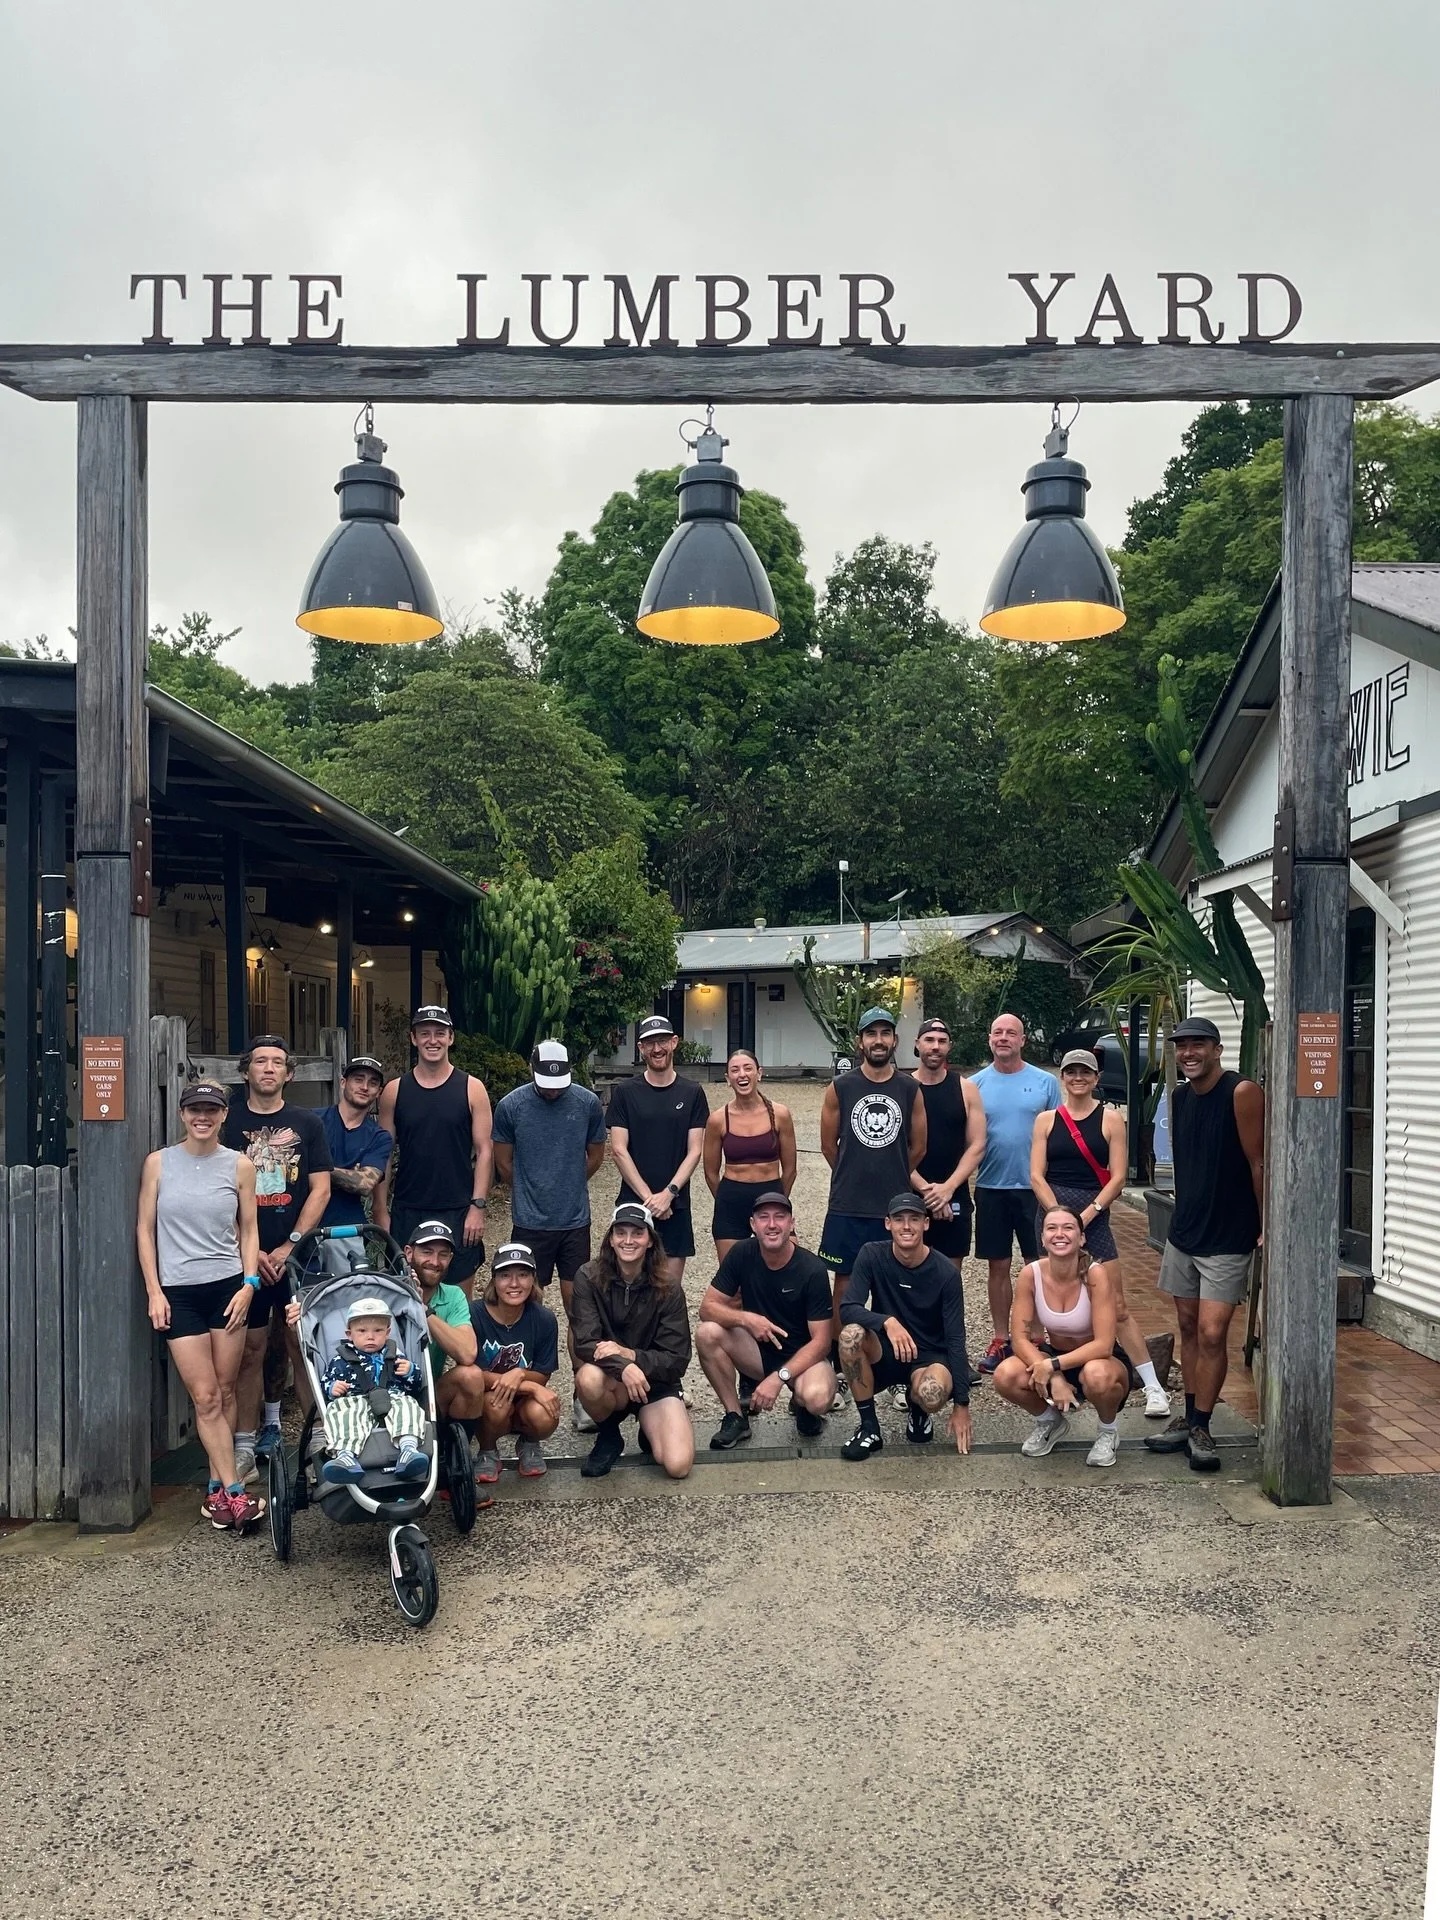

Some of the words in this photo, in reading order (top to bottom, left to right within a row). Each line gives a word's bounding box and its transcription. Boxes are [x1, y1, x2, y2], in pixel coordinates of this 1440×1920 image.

[130, 274, 344, 345] THE
[457, 273, 906, 345] LUMBER
[1008, 273, 1303, 344] YARD
[1303, 1036, 1312, 1044] NO
[1313, 1036, 1334, 1044] ENTRY
